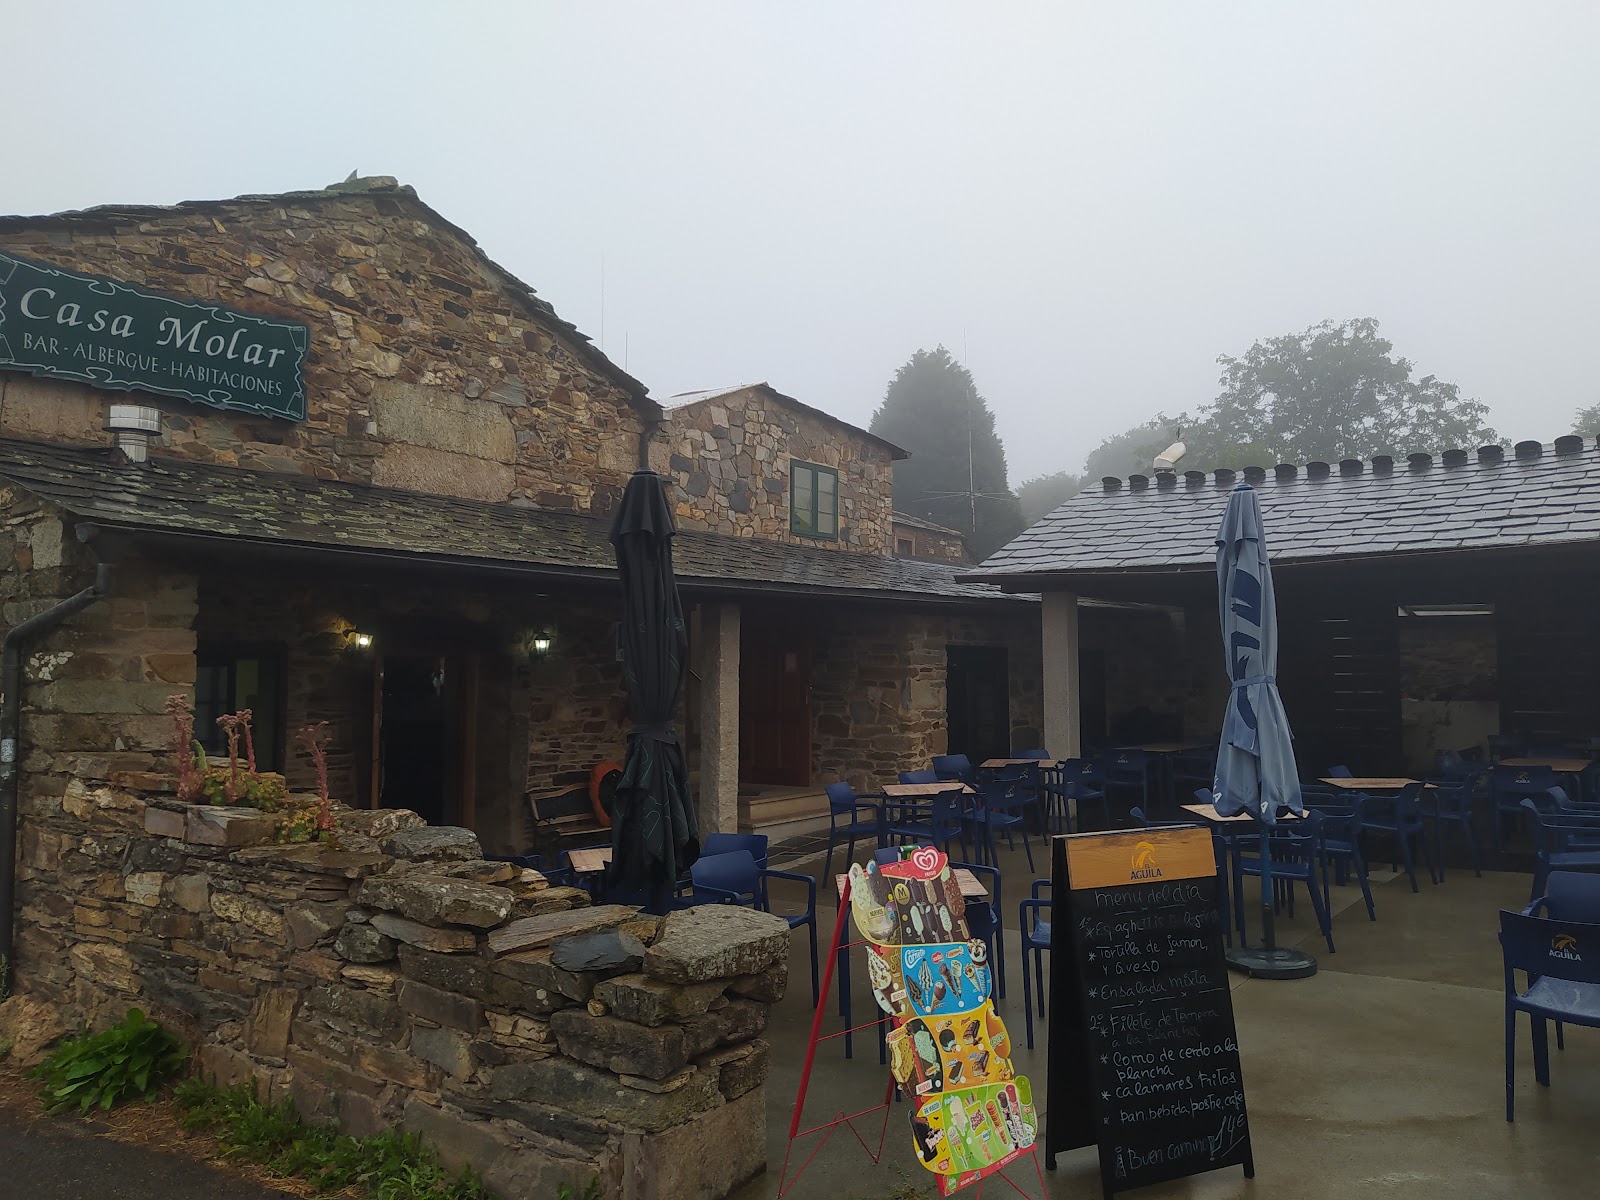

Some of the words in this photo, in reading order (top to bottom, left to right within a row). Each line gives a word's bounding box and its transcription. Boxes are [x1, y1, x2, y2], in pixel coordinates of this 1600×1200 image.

[20, 287, 136, 338] Casa
[156, 316, 286, 368] Molar
[23, 332, 60, 356] BAR
[73, 342, 159, 373] ALBERGUE
[171, 360, 283, 396] HABITACIONES
[1130, 868, 1162, 880] AGUILA
[1147, 885, 1170, 902] del
[1146, 939, 1161, 954] de
[1549, 949, 1582, 961] AGUILA
[1100, 979, 1167, 1000] Ensalada
[1169, 970, 1211, 987] mixta
[1109, 1012, 1152, 1036] Filete
[1158, 1009, 1173, 1026] de
[1159, 1047, 1176, 1062] de
[1179, 1042, 1211, 1060] cerdo
[1214, 1044, 1224, 1054] a
[1224, 1037, 1239, 1052] la
[1116, 1064, 1175, 1083] plancha
[1115, 1074, 1194, 1099] calamares
